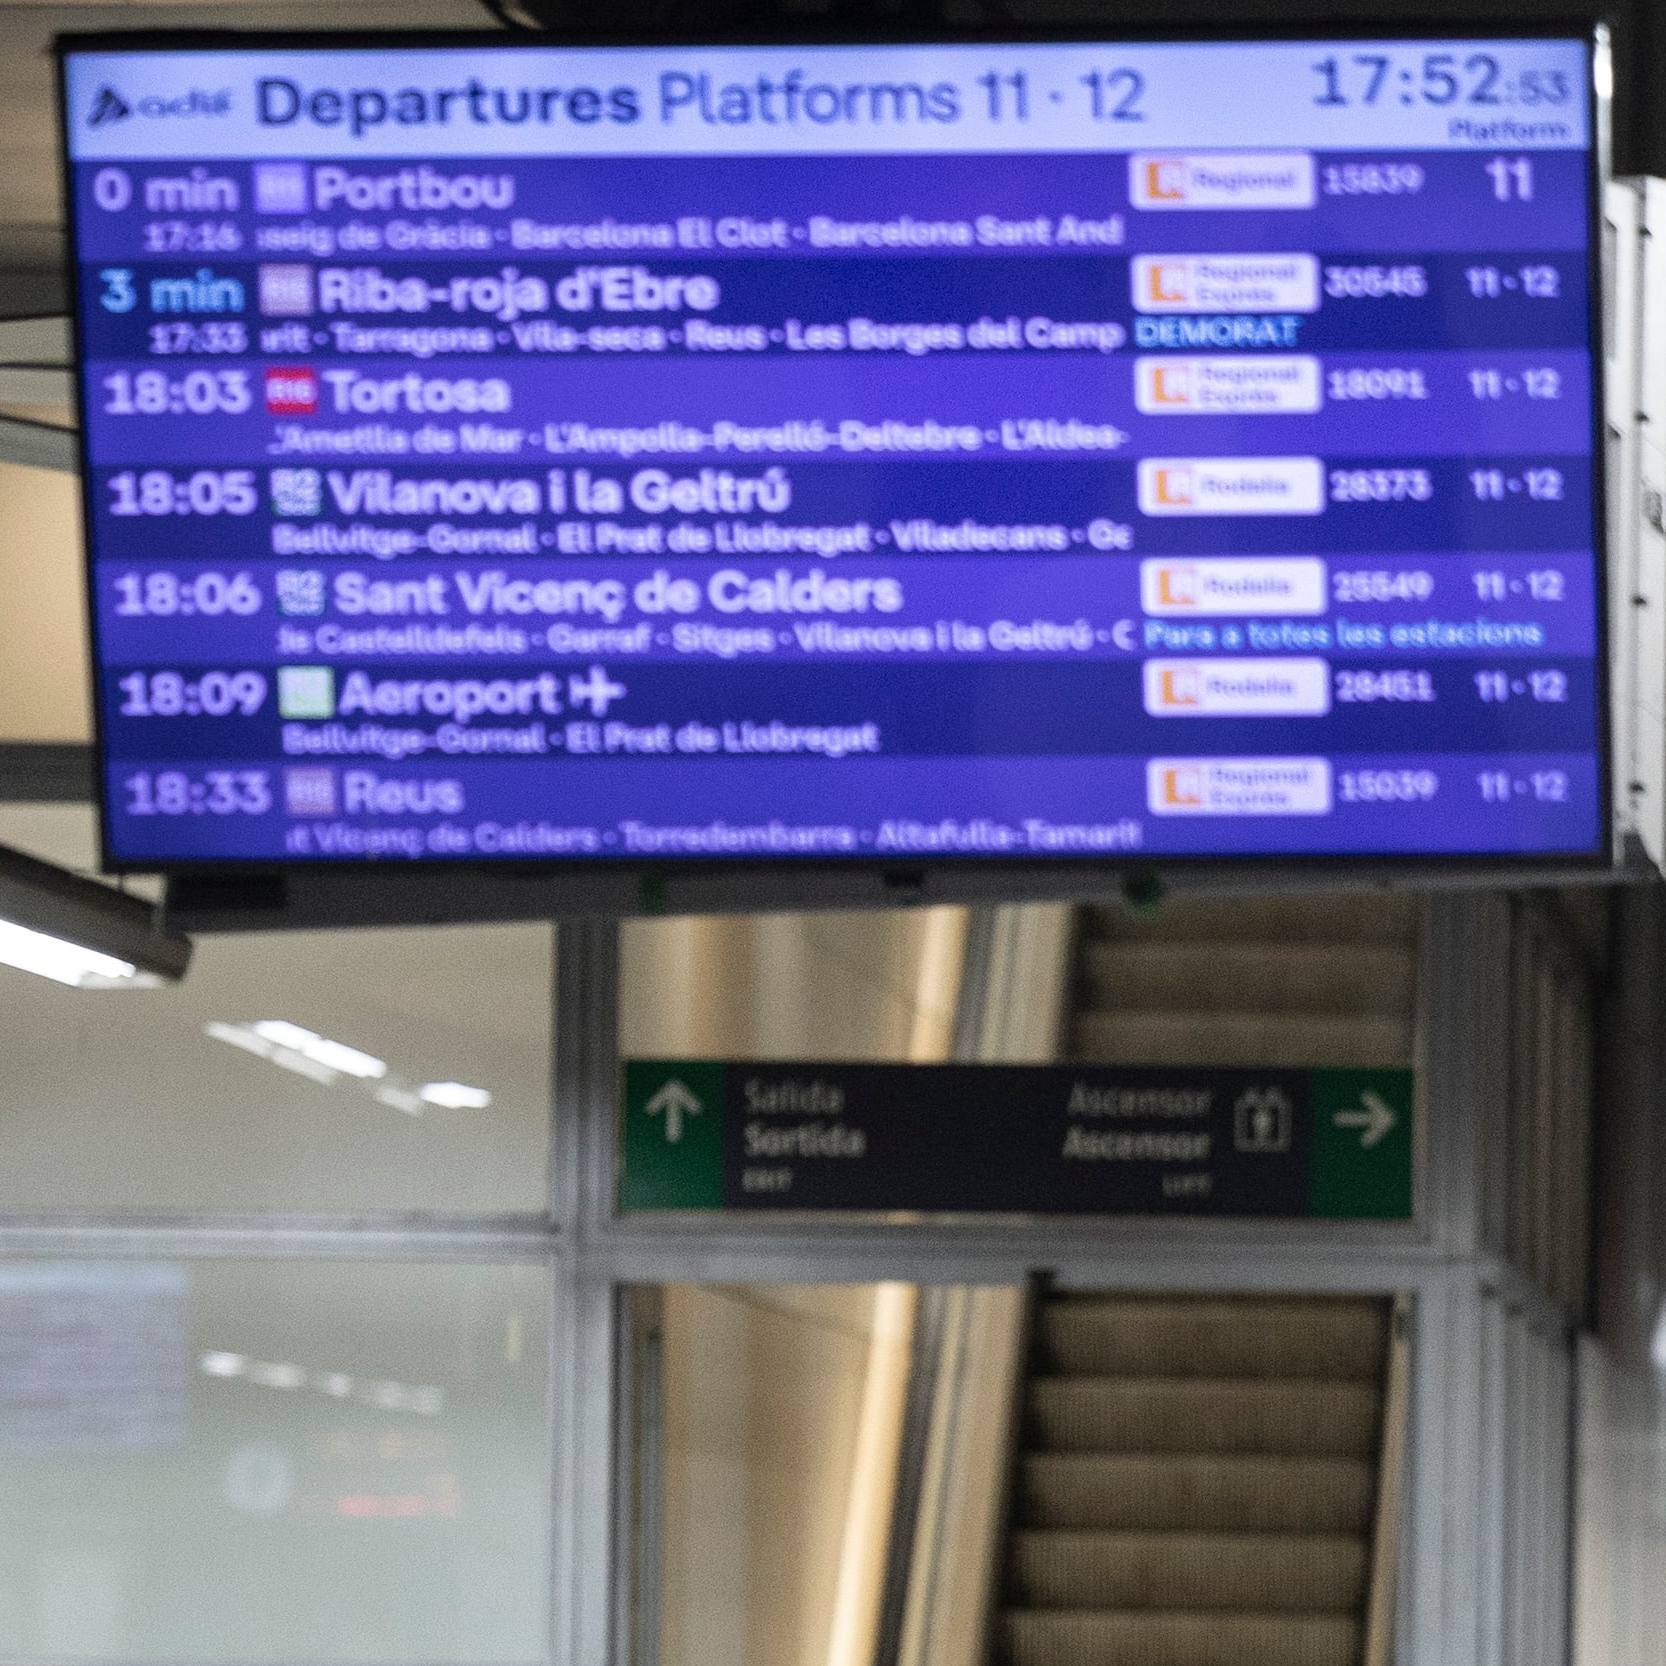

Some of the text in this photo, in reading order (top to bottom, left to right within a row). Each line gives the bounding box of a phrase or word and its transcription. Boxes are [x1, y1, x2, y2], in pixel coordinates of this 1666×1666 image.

[254, 67, 1147, 137] Departures Platforms 11 12
[1449, 118, 1571, 142] Platform
[93, 167, 131, 212] 0
[145, 167, 239, 211] min
[313, 166, 515, 211] Portbou
[1192, 169, 1296, 194] Regional
[1485, 157, 1532, 200] 11
[338, 220, 382, 250] de
[384, 218, 493, 250] Gràcia
[510, 217, 674, 250] Barcelona
[676, 216, 713, 248] El
[716, 216, 790, 248] Clot
[809, 214, 973, 247] Barcelona
[976, 214, 1052, 247] Sant
[100, 269, 134, 312] 3
[150, 269, 245, 312] min
[318, 266, 549, 321] Riba-roja
[556, 265, 721, 312] d'Ebre
[330, 321, 495, 357] Tarragona
[511, 319, 667, 352] Vila-seca
[685, 318, 768, 351] Reus
[785, 317, 847, 350] Les
[848, 317, 966, 355] Borges
[967, 316, 1024, 350] del
[1025, 316, 1127, 354] Camp
[1135, 316, 1302, 347] DEMORAT
[102, 371, 252, 415] 18:03
[321, 369, 512, 414] Tortosa
[413, 423, 459, 454] de
[460, 422, 525, 454] Mar
[108, 471, 257, 515] 18:05
[329, 464, 791, 515] Vilanova i la Geltrú
[272, 521, 537, 560] Bellvitge-Gornal
[556, 521, 591, 554] El
[595, 521, 664, 554] Prat
[667, 520, 712, 553] de
[713, 519, 874, 557] Llobregat
[890, 518, 1070, 552] Viladecans
[114, 571, 263, 615] 18:06
[334, 568, 904, 623] Sant Vicenç de Calders
[314, 622, 530, 655] Castelldefels
[546, 621, 653, 654] Garraf
[671, 620, 777, 658] Sitges
[792, 619, 932, 653] Vilanova
[951, 618, 988, 652] la
[988, 616, 1094, 652] Geltrú
[1143, 617, 1545, 650] Para a totes les estacions
[119, 671, 268, 716] 18:09
[338, 671, 559, 724] Aeroport
[281, 719, 881, 760] Bellvitge-Gornal El Prat de Llobregat
[125, 771, 272, 816] 18:33
[343, 769, 464, 815] Reus
[312, 822, 424, 859] Vicenç
[427, 821, 472, 854] de
[474, 820, 601, 854] Calders
[617, 818, 857, 853] Torredembarra
[744, 1120, 867, 1157] Sortida
[1063, 1124, 1211, 1161] Ascensor
